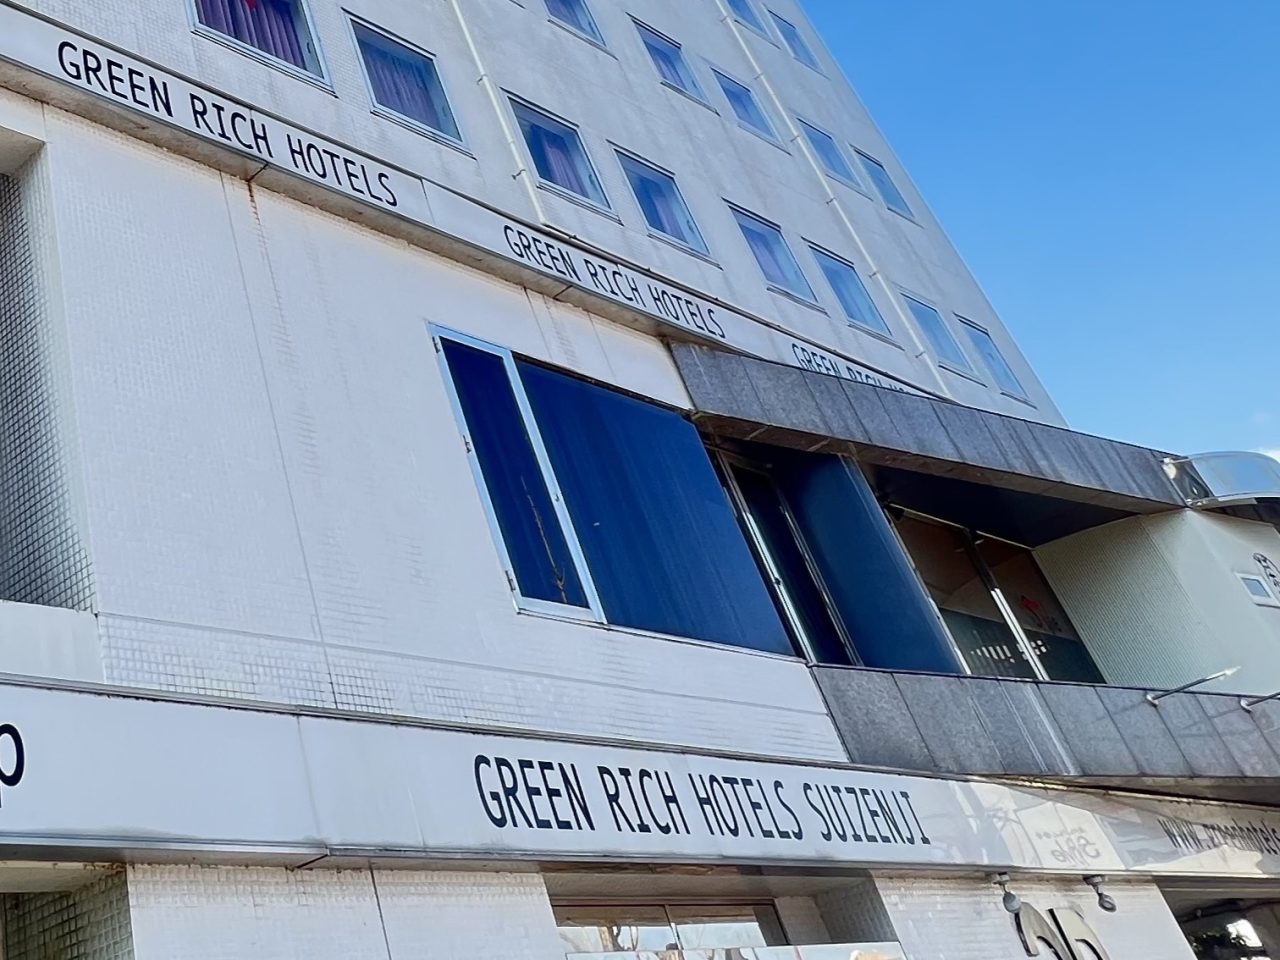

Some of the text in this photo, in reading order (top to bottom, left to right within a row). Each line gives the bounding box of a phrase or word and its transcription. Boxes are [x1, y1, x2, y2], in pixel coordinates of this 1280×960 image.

[57, 40, 399, 208] GREEN RICH HOTELS
[503, 224, 726, 340] GREEN RICH HOTELS
[473, 753, 932, 846] GREEN RICH HOTELS SUIZENJI
